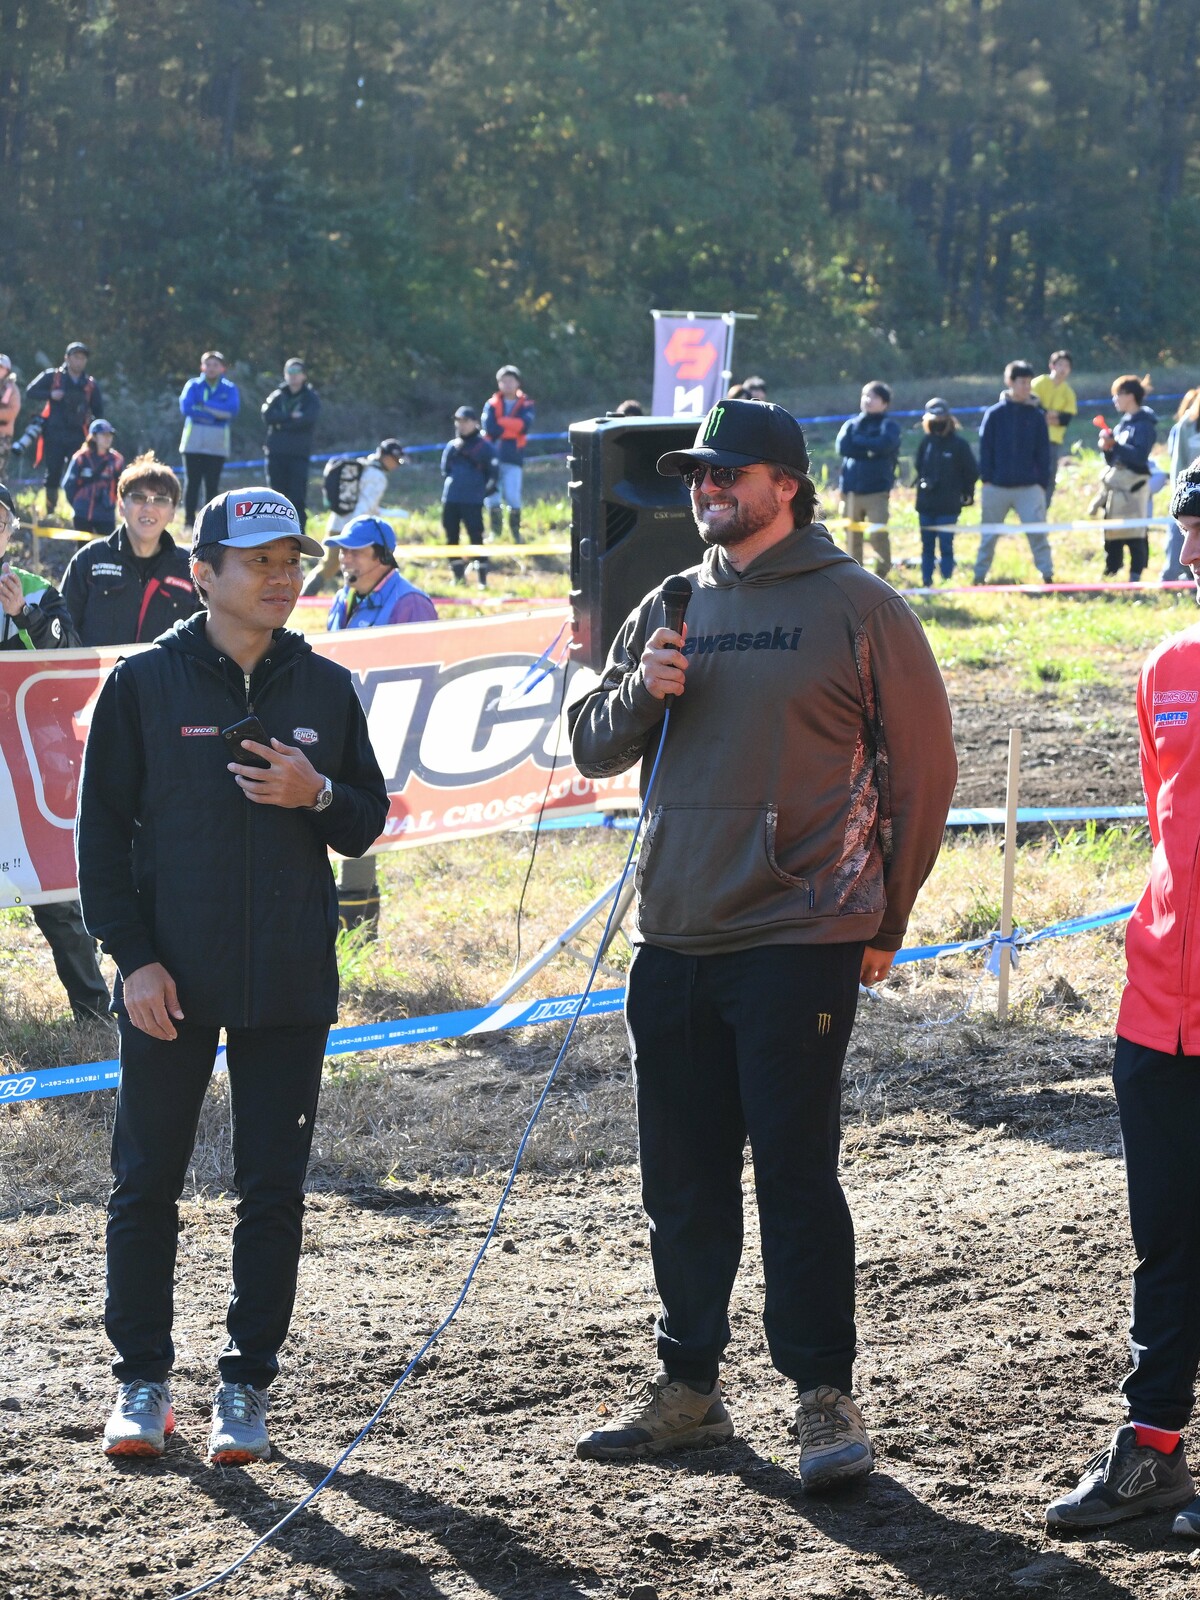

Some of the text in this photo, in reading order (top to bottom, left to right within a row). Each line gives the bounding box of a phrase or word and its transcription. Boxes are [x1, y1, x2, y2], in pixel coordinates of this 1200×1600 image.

[245, 502, 295, 520] JNCC
[681, 626, 803, 656] awasaki
[1155, 711, 1188, 722] PARTS
[526, 998, 591, 1022] JNCC
